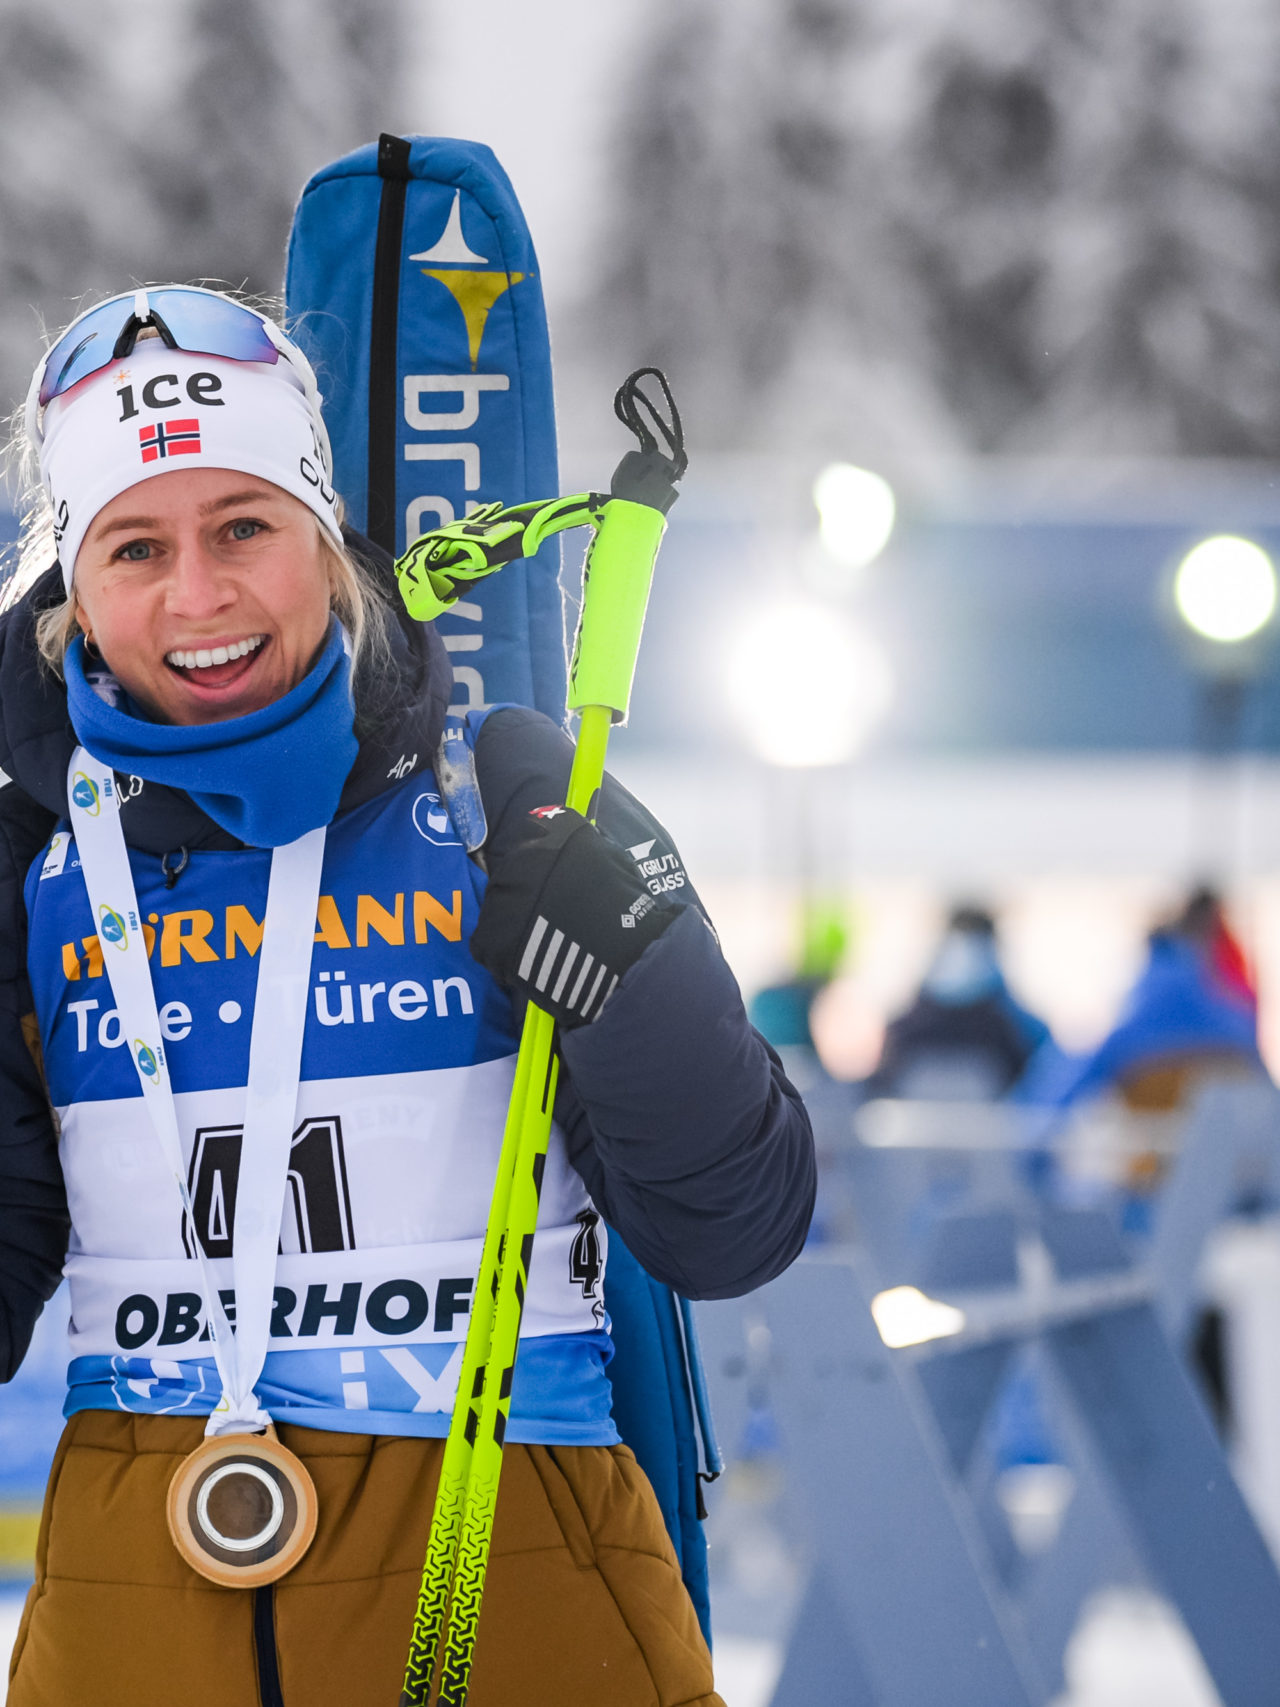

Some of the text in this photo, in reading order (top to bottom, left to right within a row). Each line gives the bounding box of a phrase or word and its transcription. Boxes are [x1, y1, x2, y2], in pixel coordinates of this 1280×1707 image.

[113, 368, 226, 422] ice
[67, 970, 474, 1052] Toe üren
[181, 1115, 356, 1259] 41
